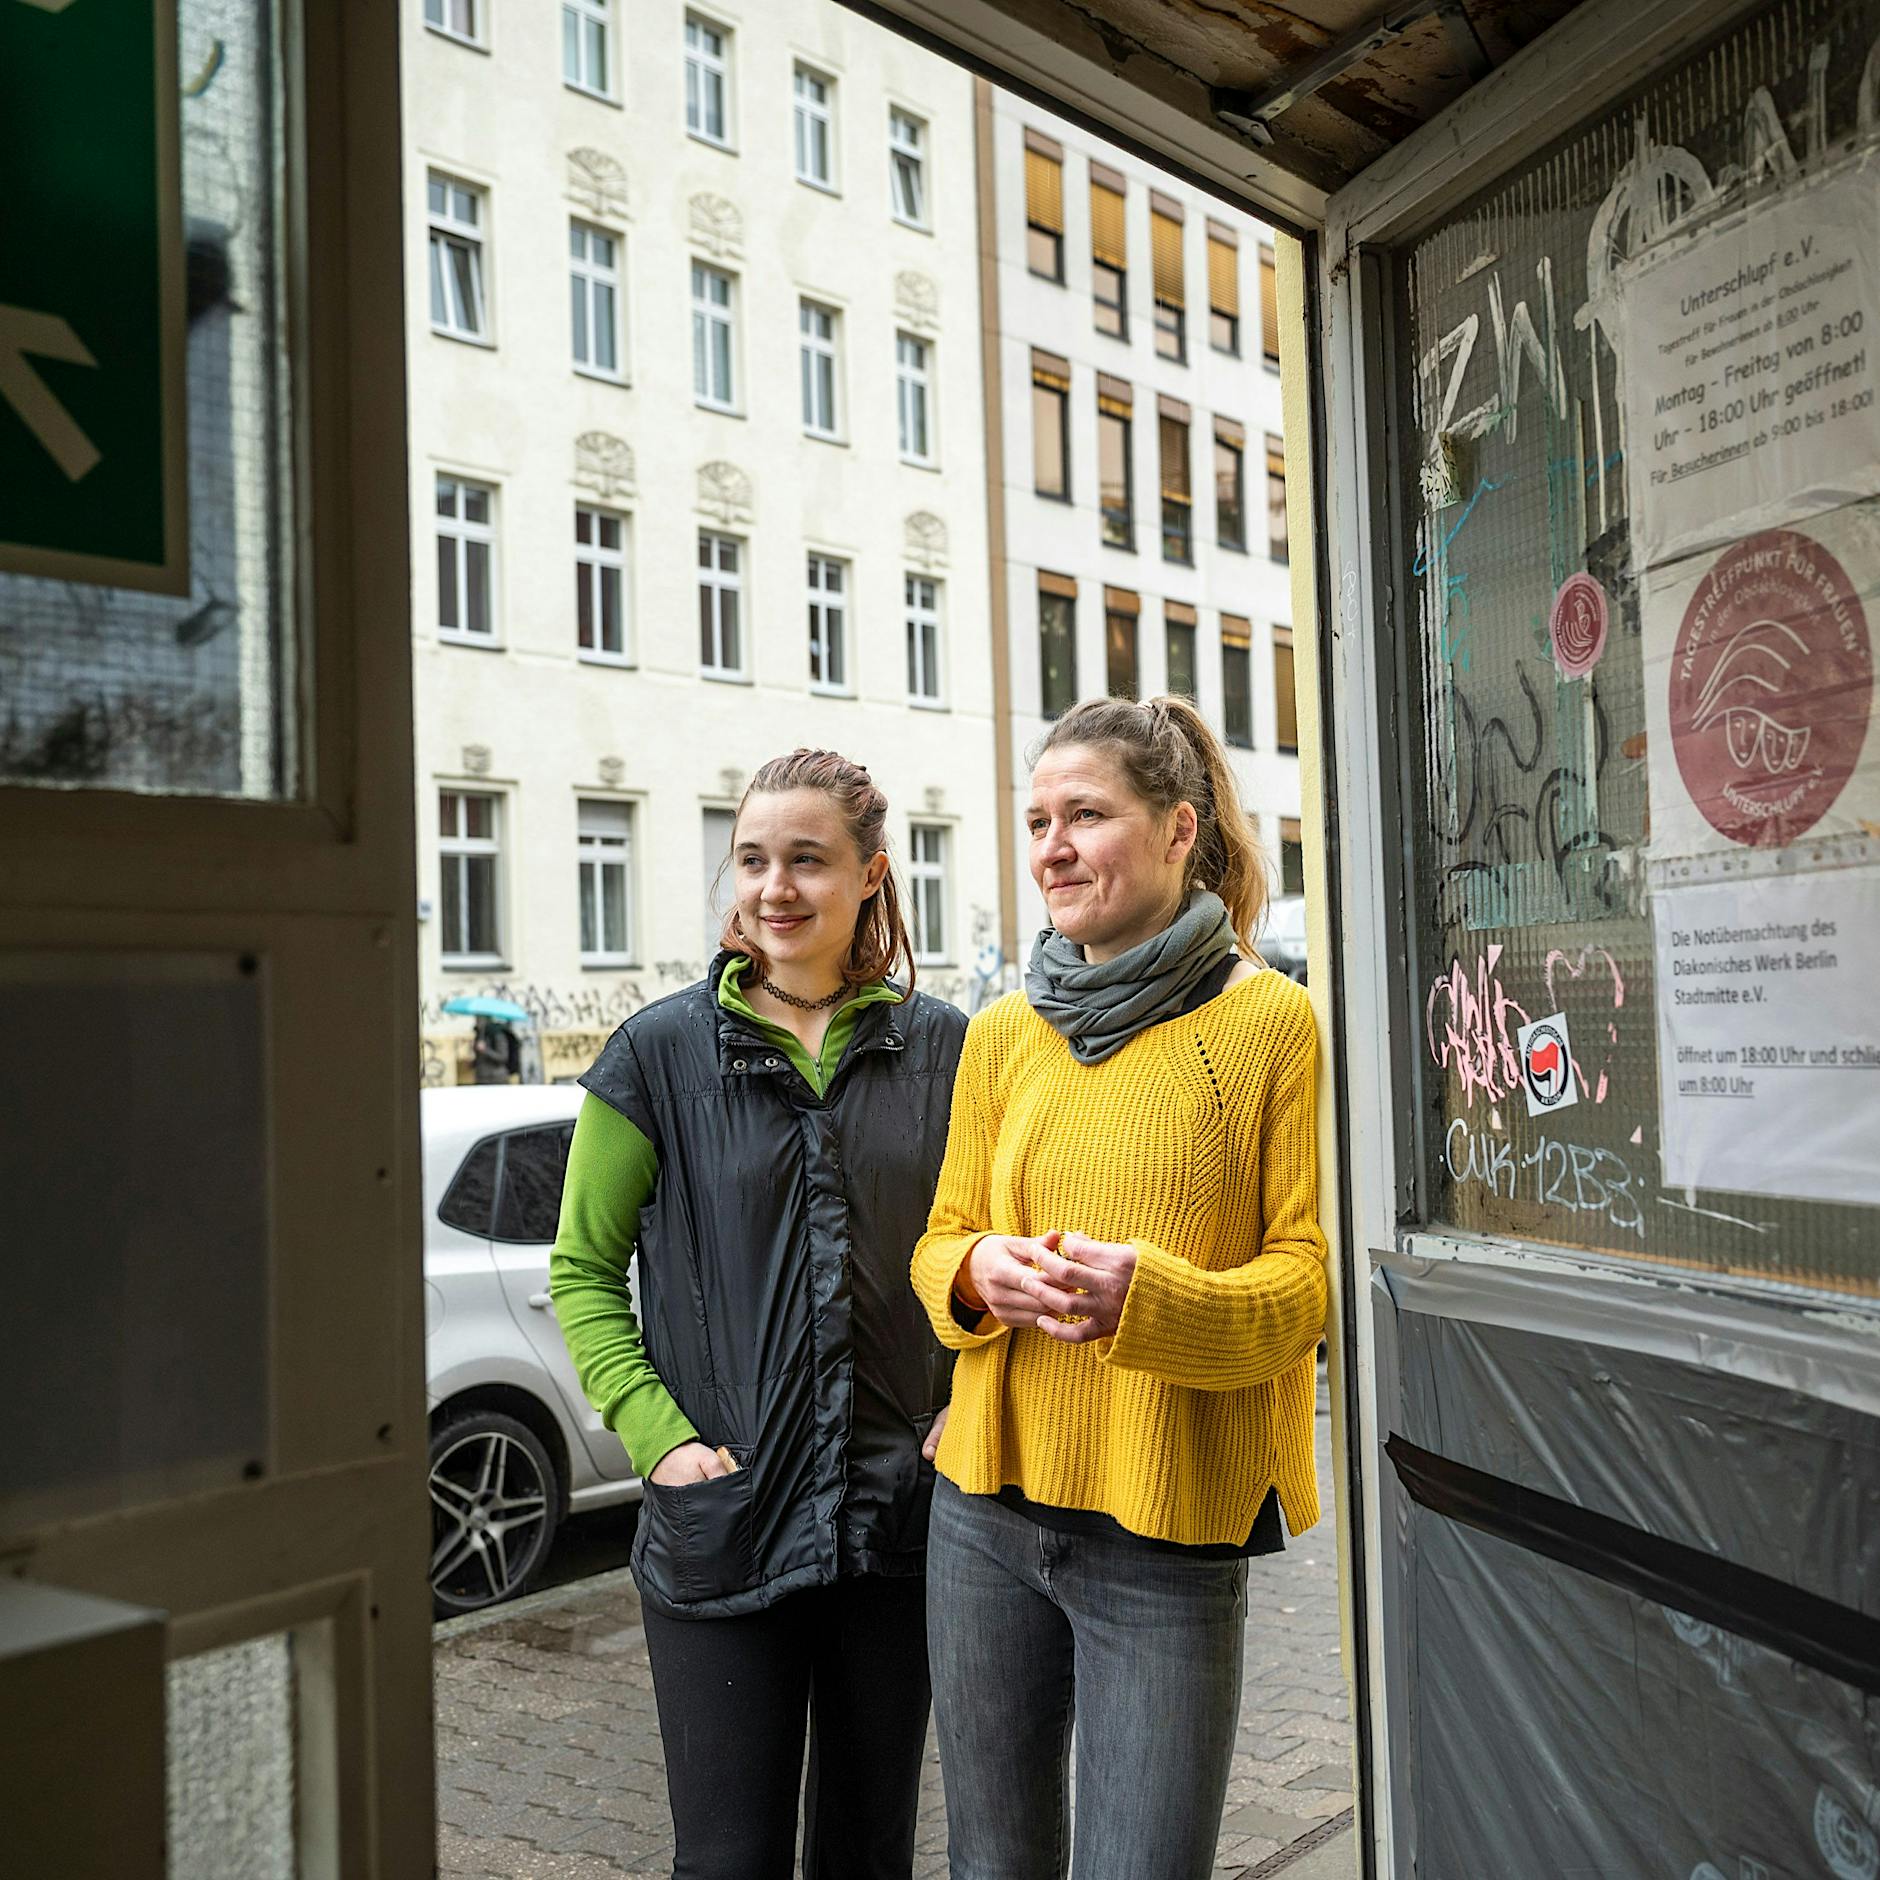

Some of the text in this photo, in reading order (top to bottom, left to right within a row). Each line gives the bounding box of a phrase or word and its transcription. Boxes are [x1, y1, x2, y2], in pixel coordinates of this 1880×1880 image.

[1681, 235, 1820, 316] Unterschlupf e.V.
[1658, 326, 1700, 355] Tagestreff
[1703, 320, 1717, 336] für
[1719, 308, 1748, 327] Frauen
[1750, 302, 1759, 313] in
[1761, 294, 1776, 308] der
[1685, 352, 1699, 368] für
[1763, 320, 1773, 333] ab
[1801, 300, 1820, 316] Uhr
[1655, 383, 1705, 417] Montag
[1724, 352, 1780, 389] Freitag
[1786, 336, 1814, 360] von
[1821, 311, 1863, 346] 8:00
[1654, 428, 1679, 451] Uhr
[1699, 399, 1745, 433] 18:00
[1750, 388, 1779, 414] Uhr
[1785, 348, 1867, 406] geöffnet!
[1650, 469, 1668, 487] Für
[1671, 439, 1750, 479] Besucherinnen
[1753, 431, 1768, 449] ab
[1771, 416, 1801, 441] 9:00
[1805, 409, 1825, 428] bis
[1680, 550, 1785, 680] TAGESTREFFPUNKT
[1786, 550, 1816, 583] FÜR
[1815, 573, 1859, 652] FRAUEN
[1722, 782, 1806, 817] UNTERSCHLUPF
[1672, 918, 1837, 947] Die Notübernachtung des
[1673, 950, 1838, 976] Diakonisches Werk Berlin
[1674, 985, 1767, 1005] Stadtmitte e.V.
[1677, 1046, 1713, 1064] öffnet
[1716, 1051, 1737, 1064] um
[1741, 1047, 1777, 1064] 18:00
[1780, 1046, 1807, 1064] Uhr
[1809, 1046, 1837, 1064] und
[1678, 1077, 1754, 1094] um 8:00 Uhr
